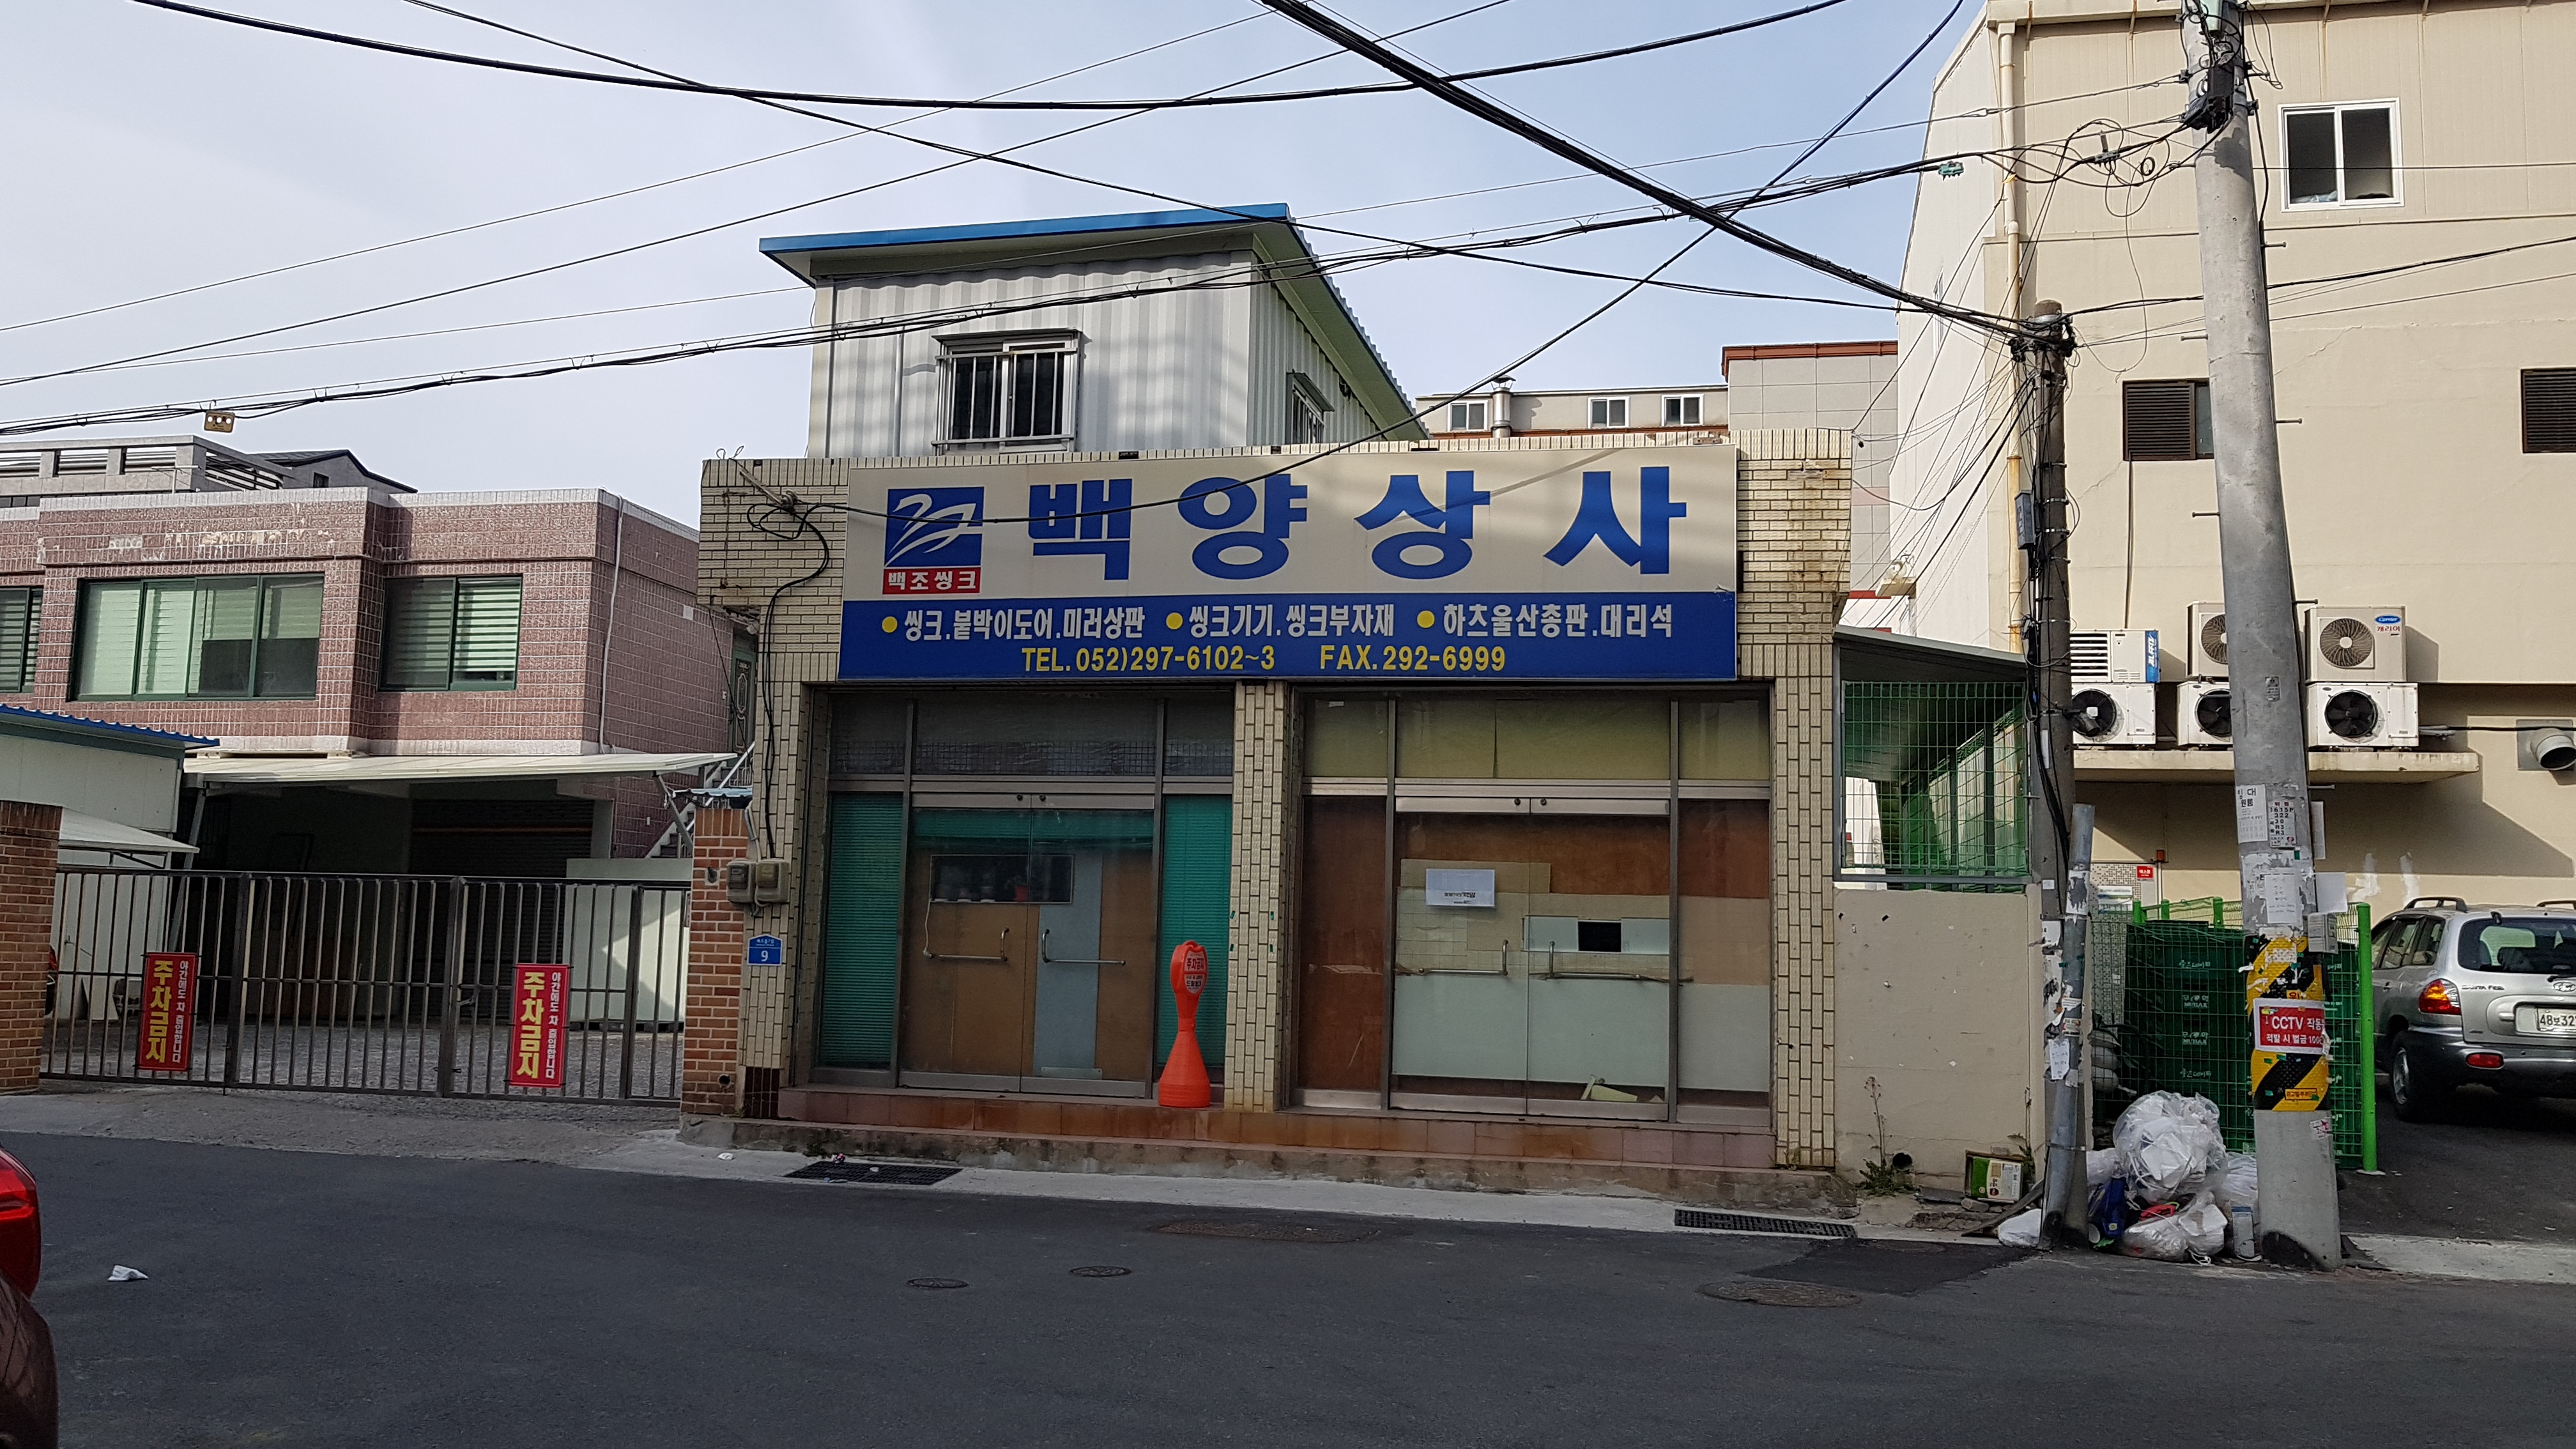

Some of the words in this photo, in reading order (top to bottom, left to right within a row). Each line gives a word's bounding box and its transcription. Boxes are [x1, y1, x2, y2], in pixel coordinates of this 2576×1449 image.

[1029, 466, 1687, 580] 백양상사
[888, 571, 977, 590] 백조씽크
[761, 950, 769, 962] 9
[550, 972, 562, 1012] 야간에도
[146, 960, 174, 1063] 주차금지
[2540, 1014, 2576, 1027] 48보32
[516, 971, 546, 1079] 주차금지
[2271, 1016, 2304, 1030] CCTV
[2266, 1033, 2280, 1043] 적발
[2283, 1034, 2290, 1043] 시
[2292, 1034, 2307, 1045] 벌금
